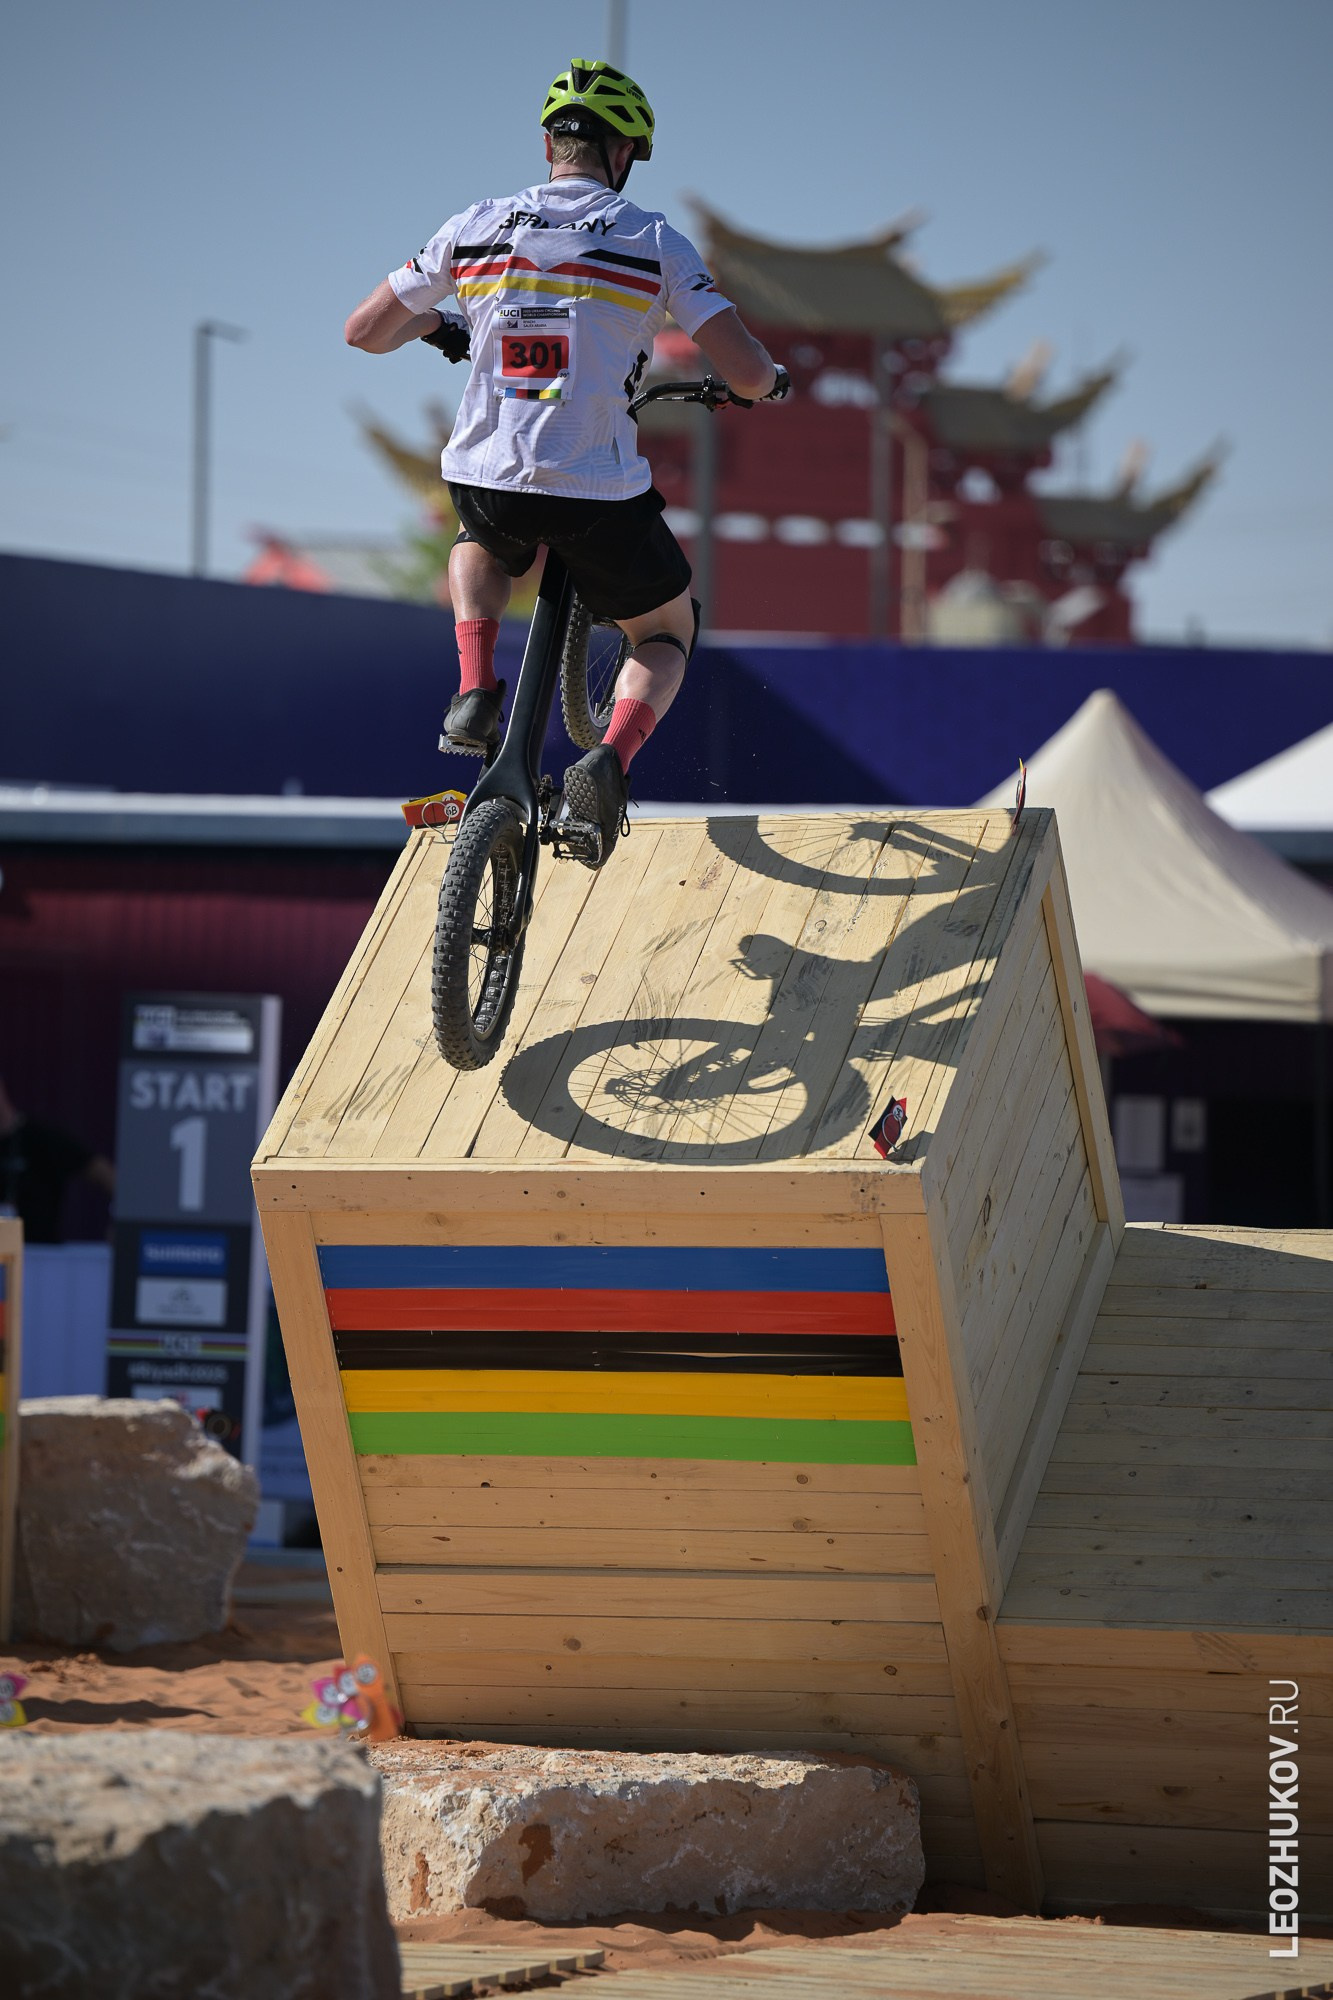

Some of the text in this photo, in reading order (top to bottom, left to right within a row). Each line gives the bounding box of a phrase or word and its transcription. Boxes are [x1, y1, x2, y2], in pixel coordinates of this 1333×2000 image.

[503, 309, 519, 317] UCI
[508, 342, 561, 368] 301
[130, 1072, 251, 1110] START
[169, 1117, 207, 1211] 1
